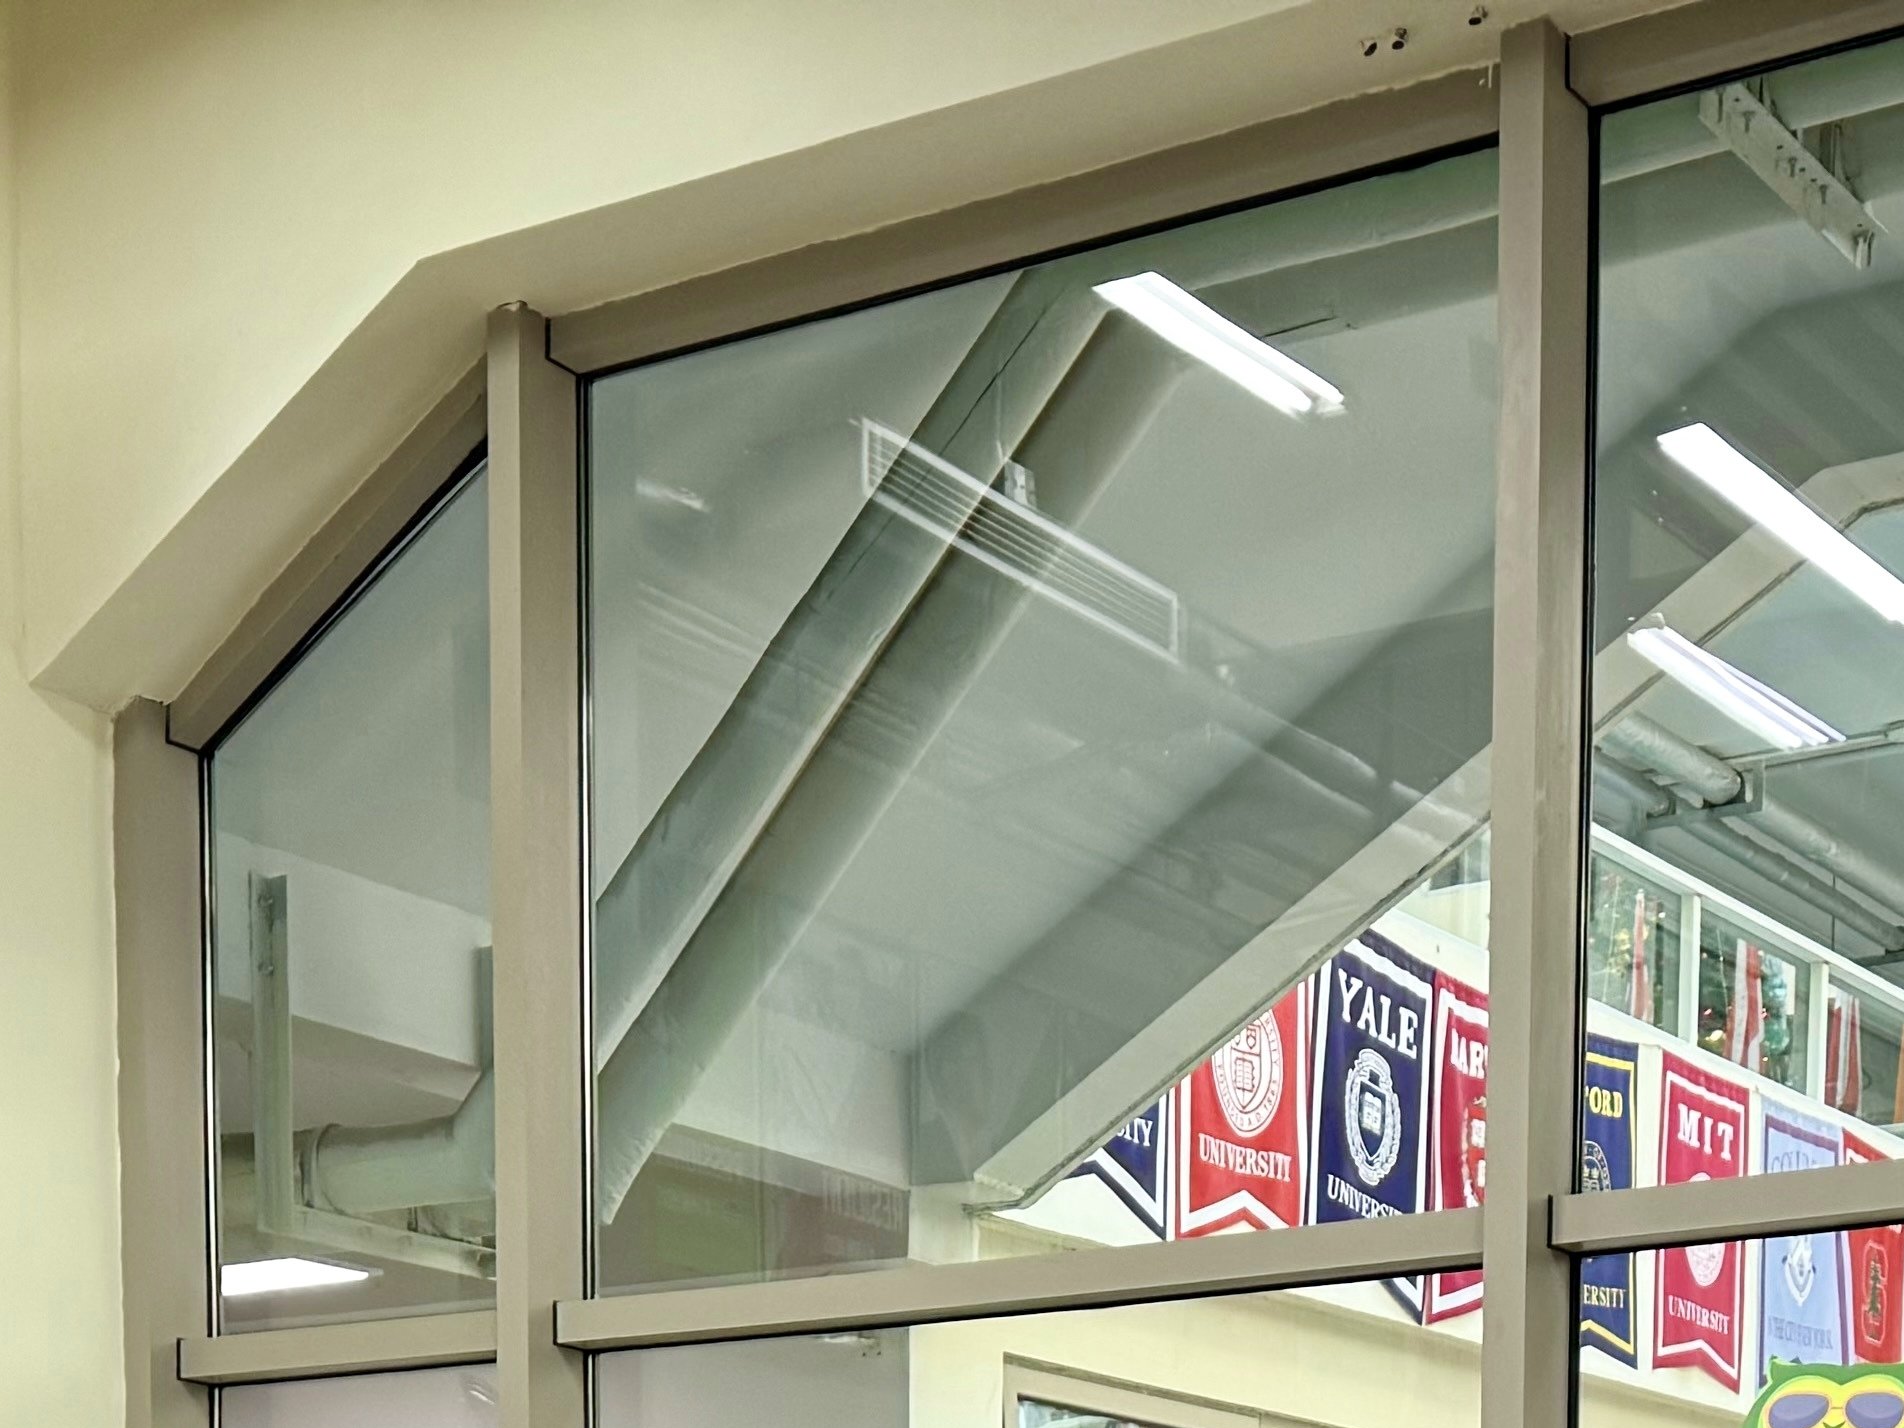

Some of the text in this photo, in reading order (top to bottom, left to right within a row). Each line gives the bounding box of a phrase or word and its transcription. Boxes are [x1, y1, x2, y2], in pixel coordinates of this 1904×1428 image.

[1338, 968, 1419, 1060] YALE
[1586, 1087, 1623, 1119] ORD
[1677, 1103, 1734, 1161] MIT
[1668, 1294, 1730, 1336] UNIVERSITY
